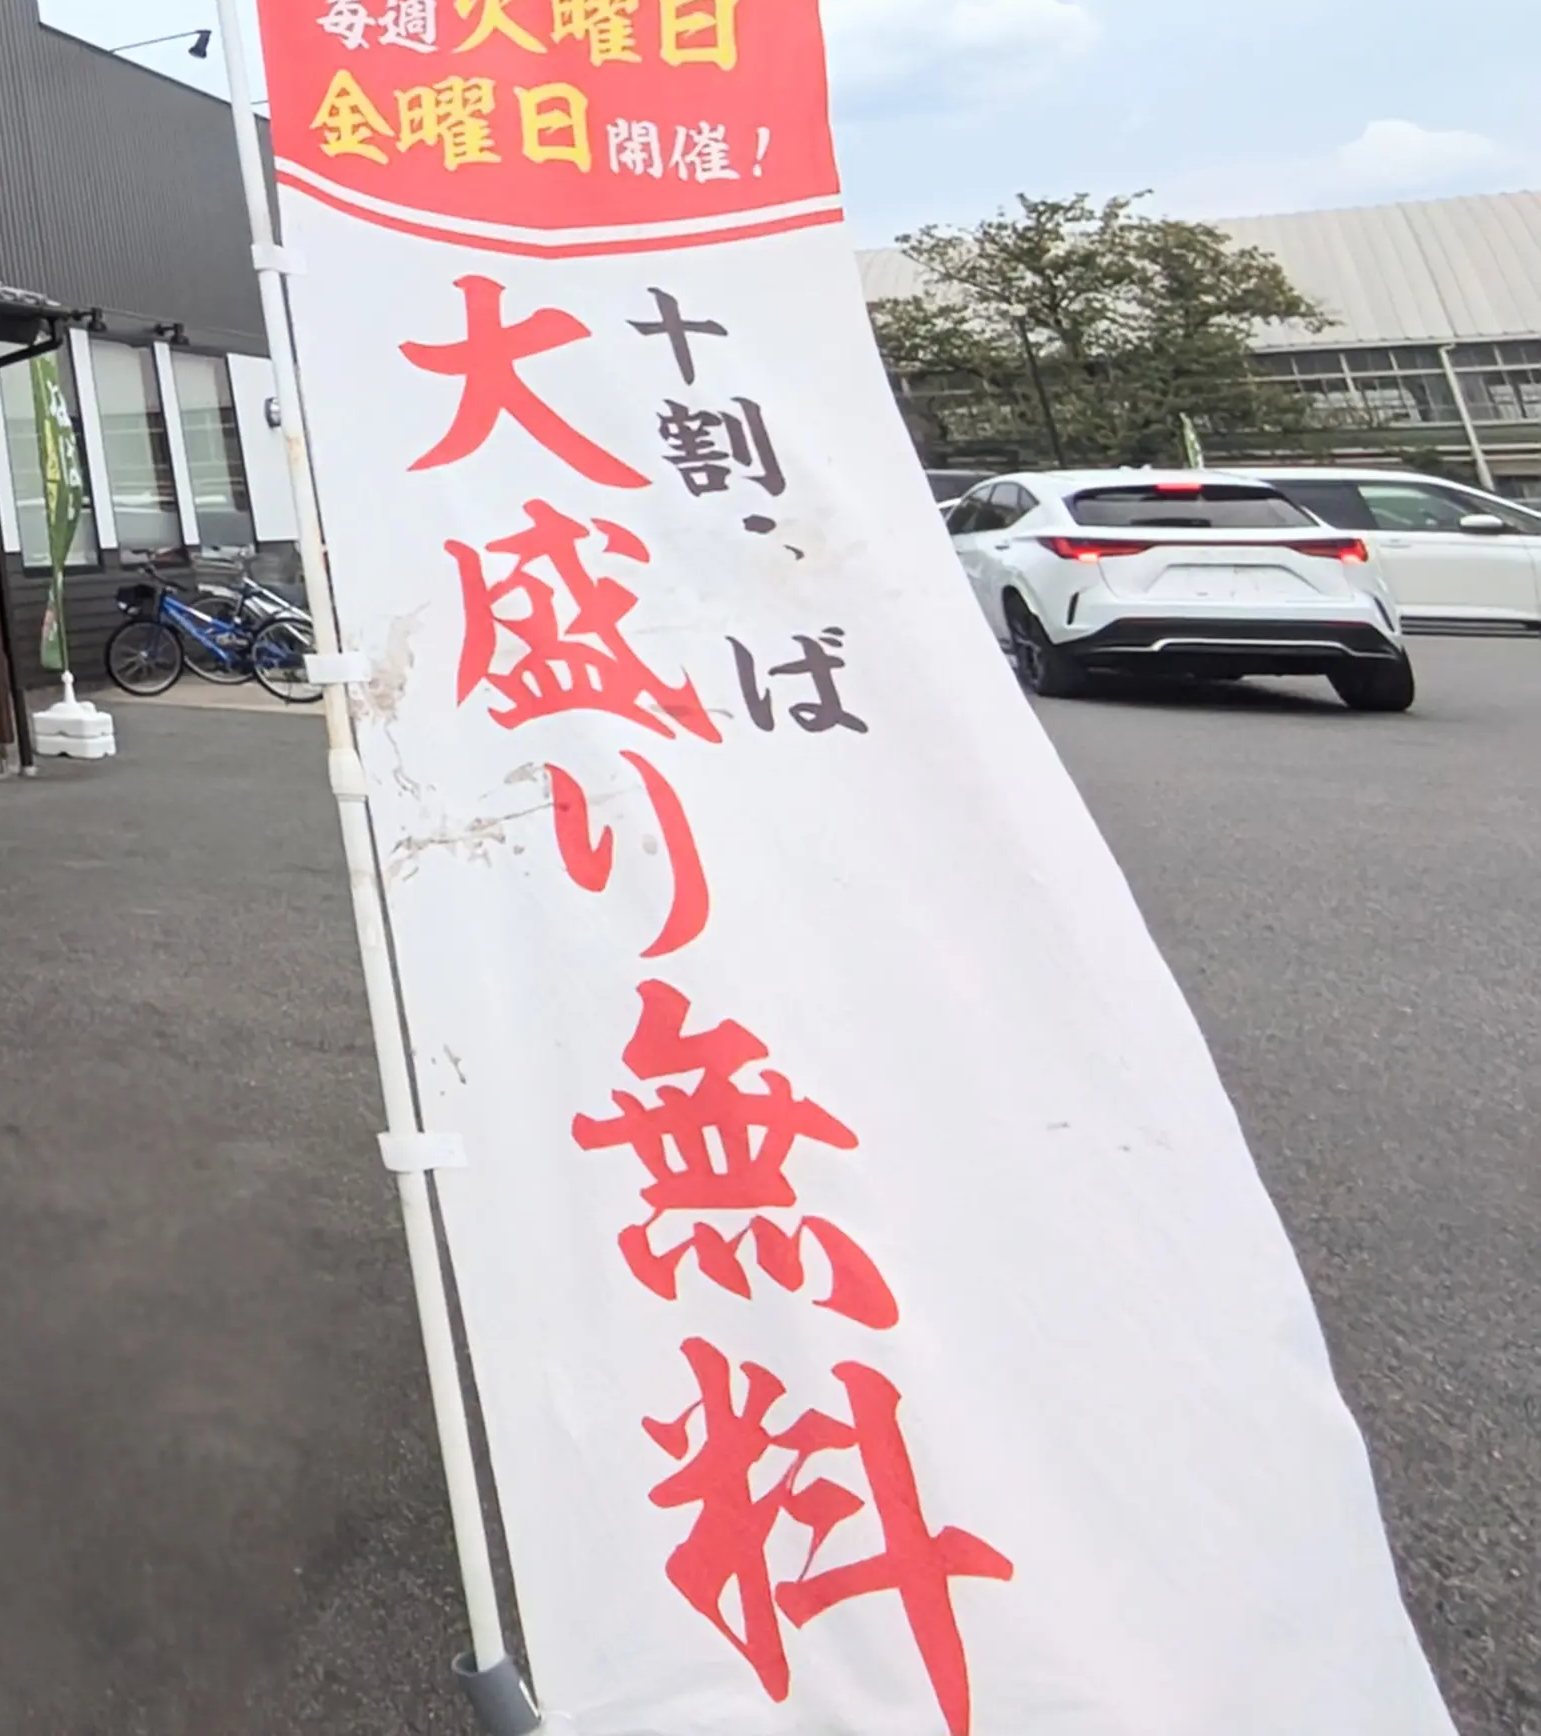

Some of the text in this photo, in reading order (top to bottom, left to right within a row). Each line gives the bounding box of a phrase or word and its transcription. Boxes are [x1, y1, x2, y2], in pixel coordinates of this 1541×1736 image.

[308, 68, 773, 185] 金曜日開催！
[623, 285, 870, 735] 十割ば
[396, 272, 1015, 1736] 大盛り無料
